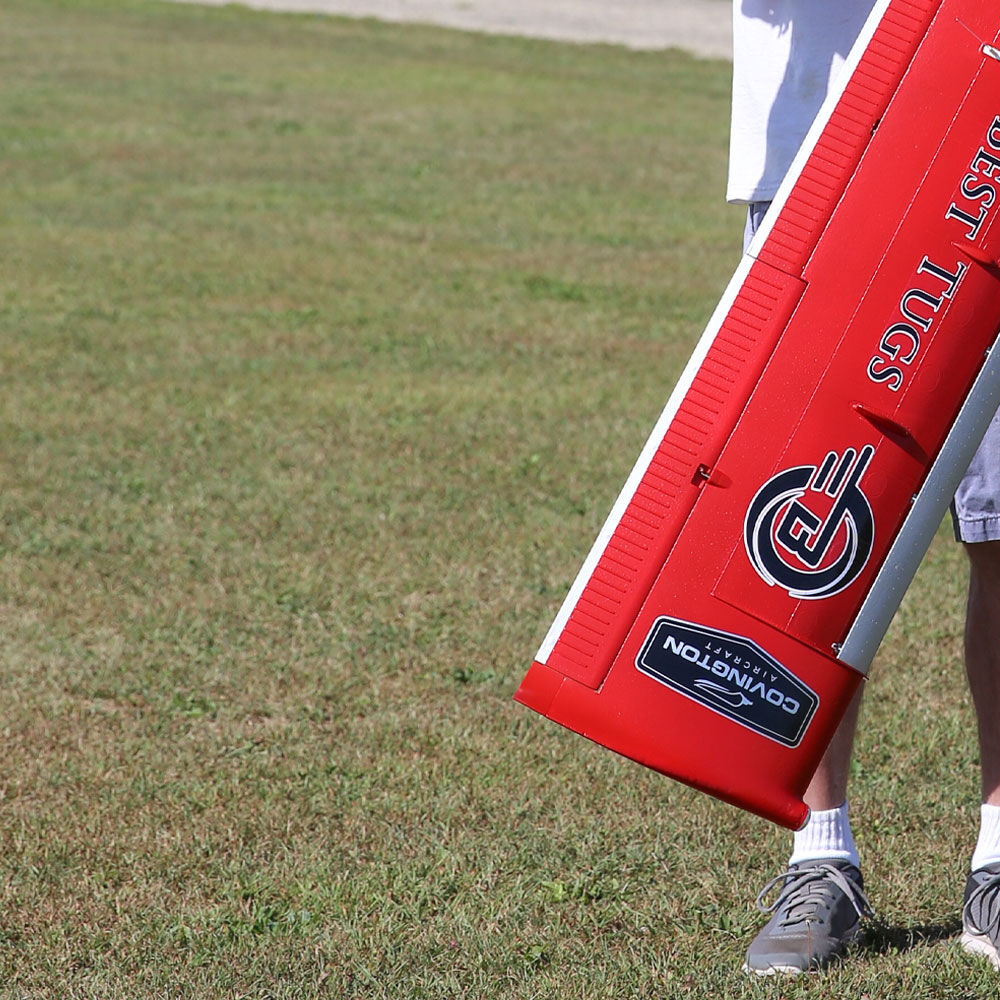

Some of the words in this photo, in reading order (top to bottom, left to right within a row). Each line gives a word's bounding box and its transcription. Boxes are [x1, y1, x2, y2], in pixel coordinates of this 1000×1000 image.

[866, 255, 967, 392] TUGS
[663, 635, 801, 716] COVINGTON
[704, 640, 778, 682] AIRCRAFT
